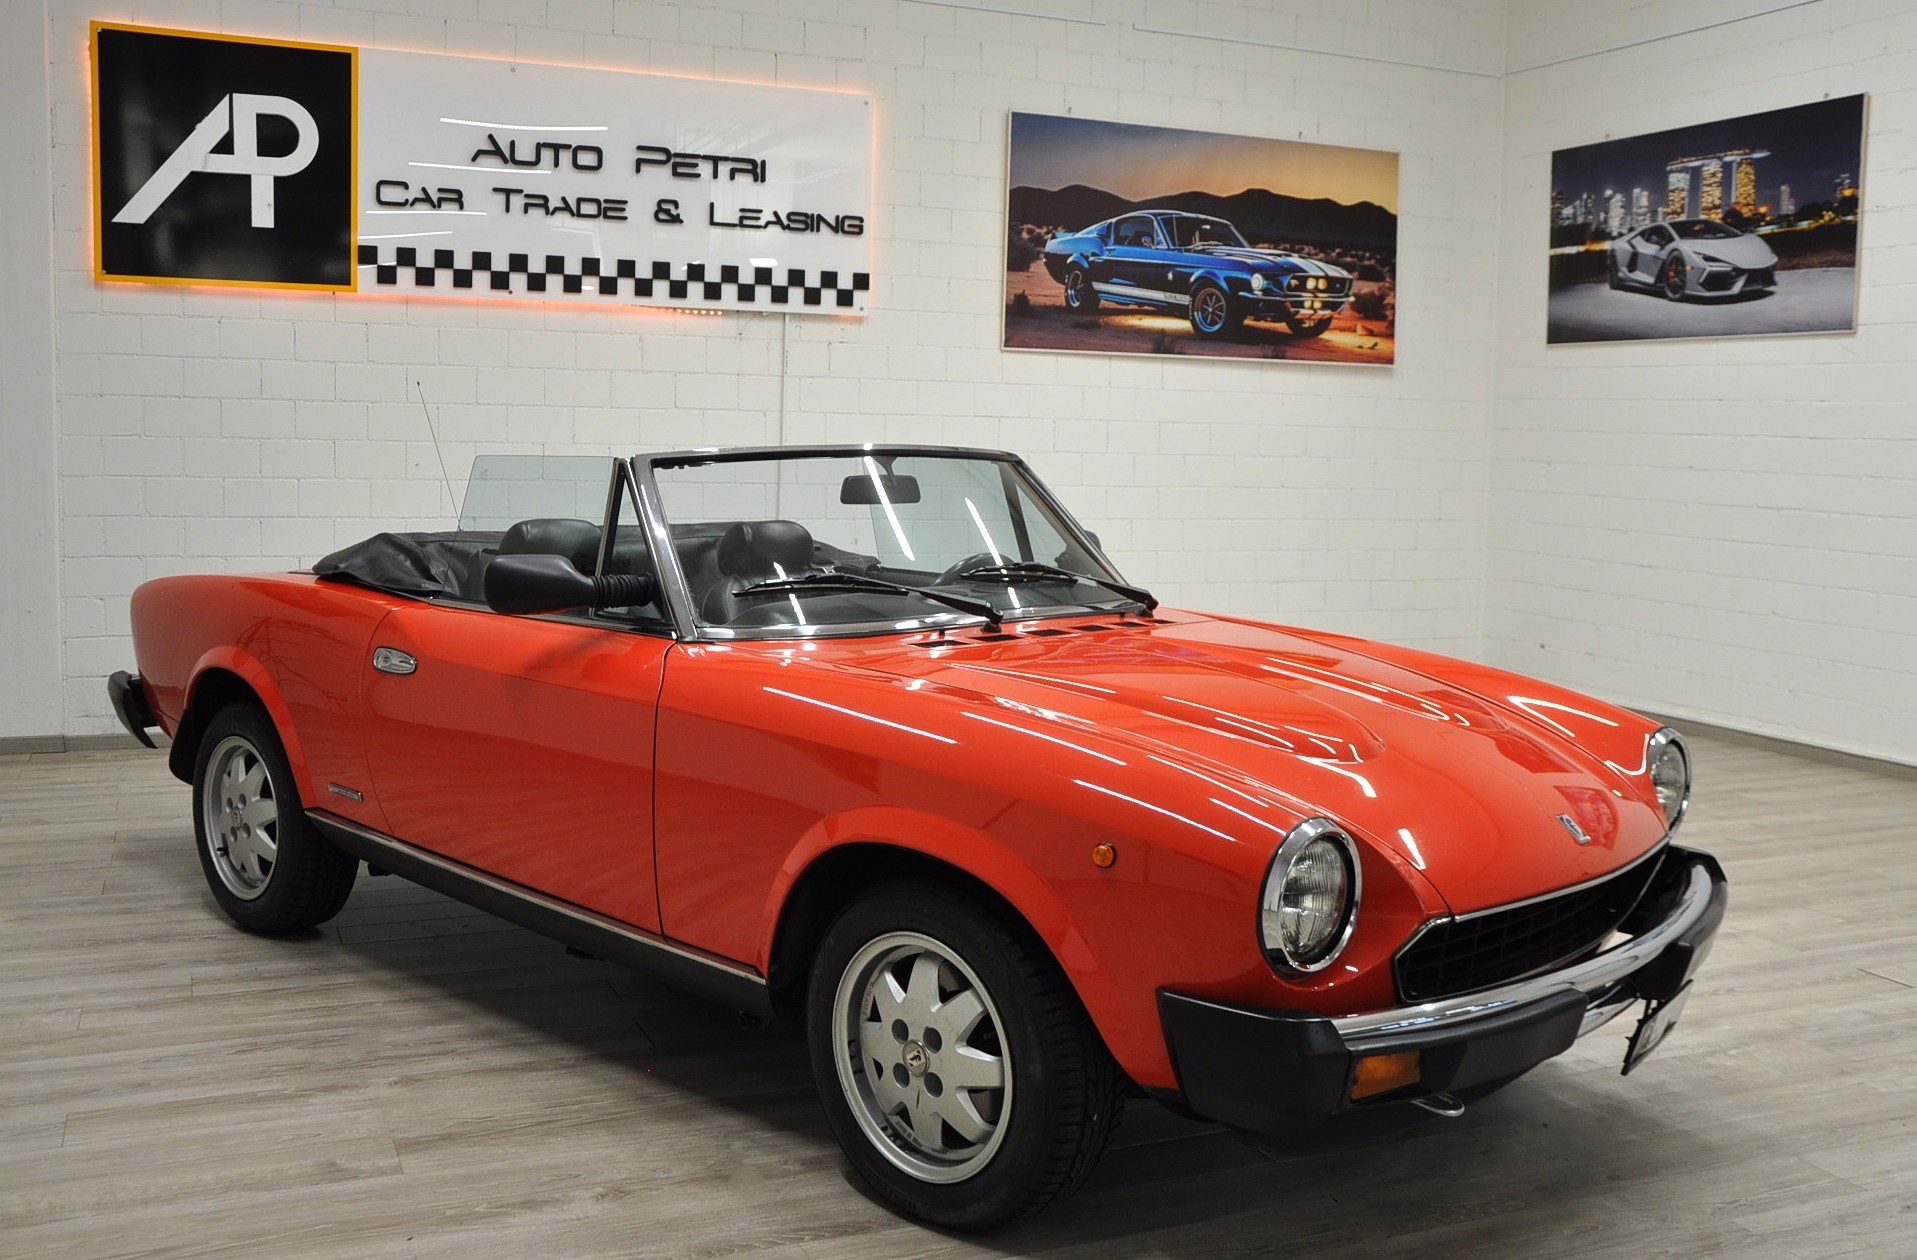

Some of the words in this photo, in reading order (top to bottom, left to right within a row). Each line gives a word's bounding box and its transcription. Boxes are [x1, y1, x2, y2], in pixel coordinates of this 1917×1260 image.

[111, 93, 319, 228] AP
[471, 133, 603, 171] AUTO
[635, 145, 766, 183] PETRI
[376, 179, 464, 210] CAR
[492, 187, 628, 220] TRADE
[654, 199, 684, 224] &
[709, 201, 864, 235] LEASING
